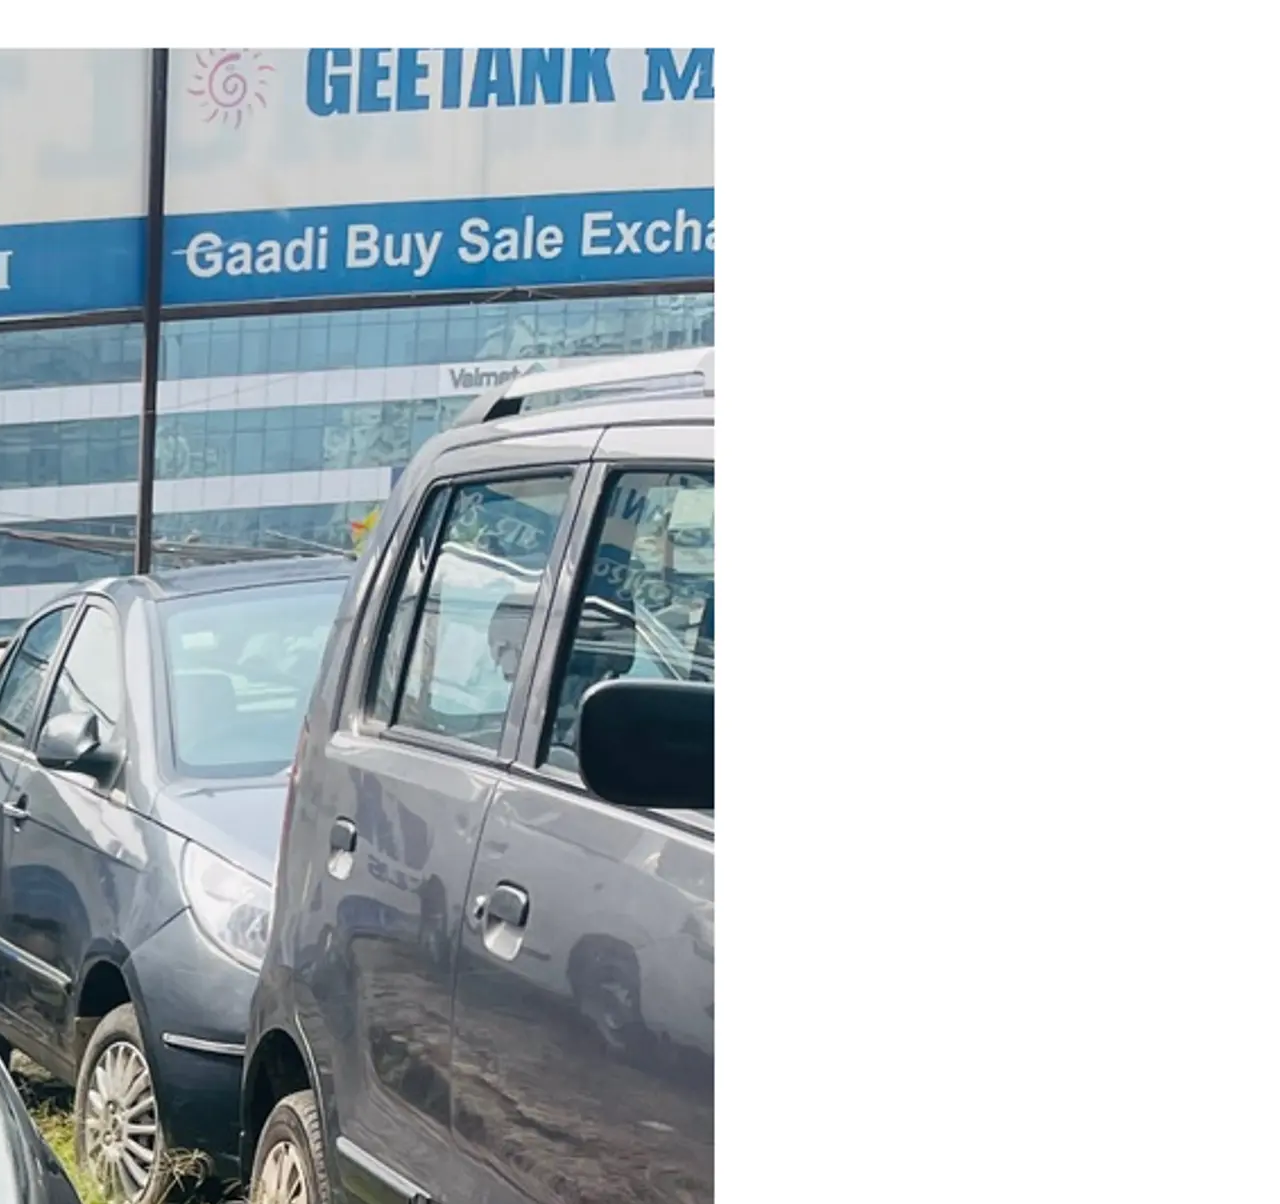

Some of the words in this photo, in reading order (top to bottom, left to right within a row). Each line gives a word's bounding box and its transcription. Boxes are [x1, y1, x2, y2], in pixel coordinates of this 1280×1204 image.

[306, 48, 616, 116] GEETANK
[186, 226, 328, 278] Gaadi
[346, 223, 443, 277] Buy
[458, 215, 564, 263] Sale
